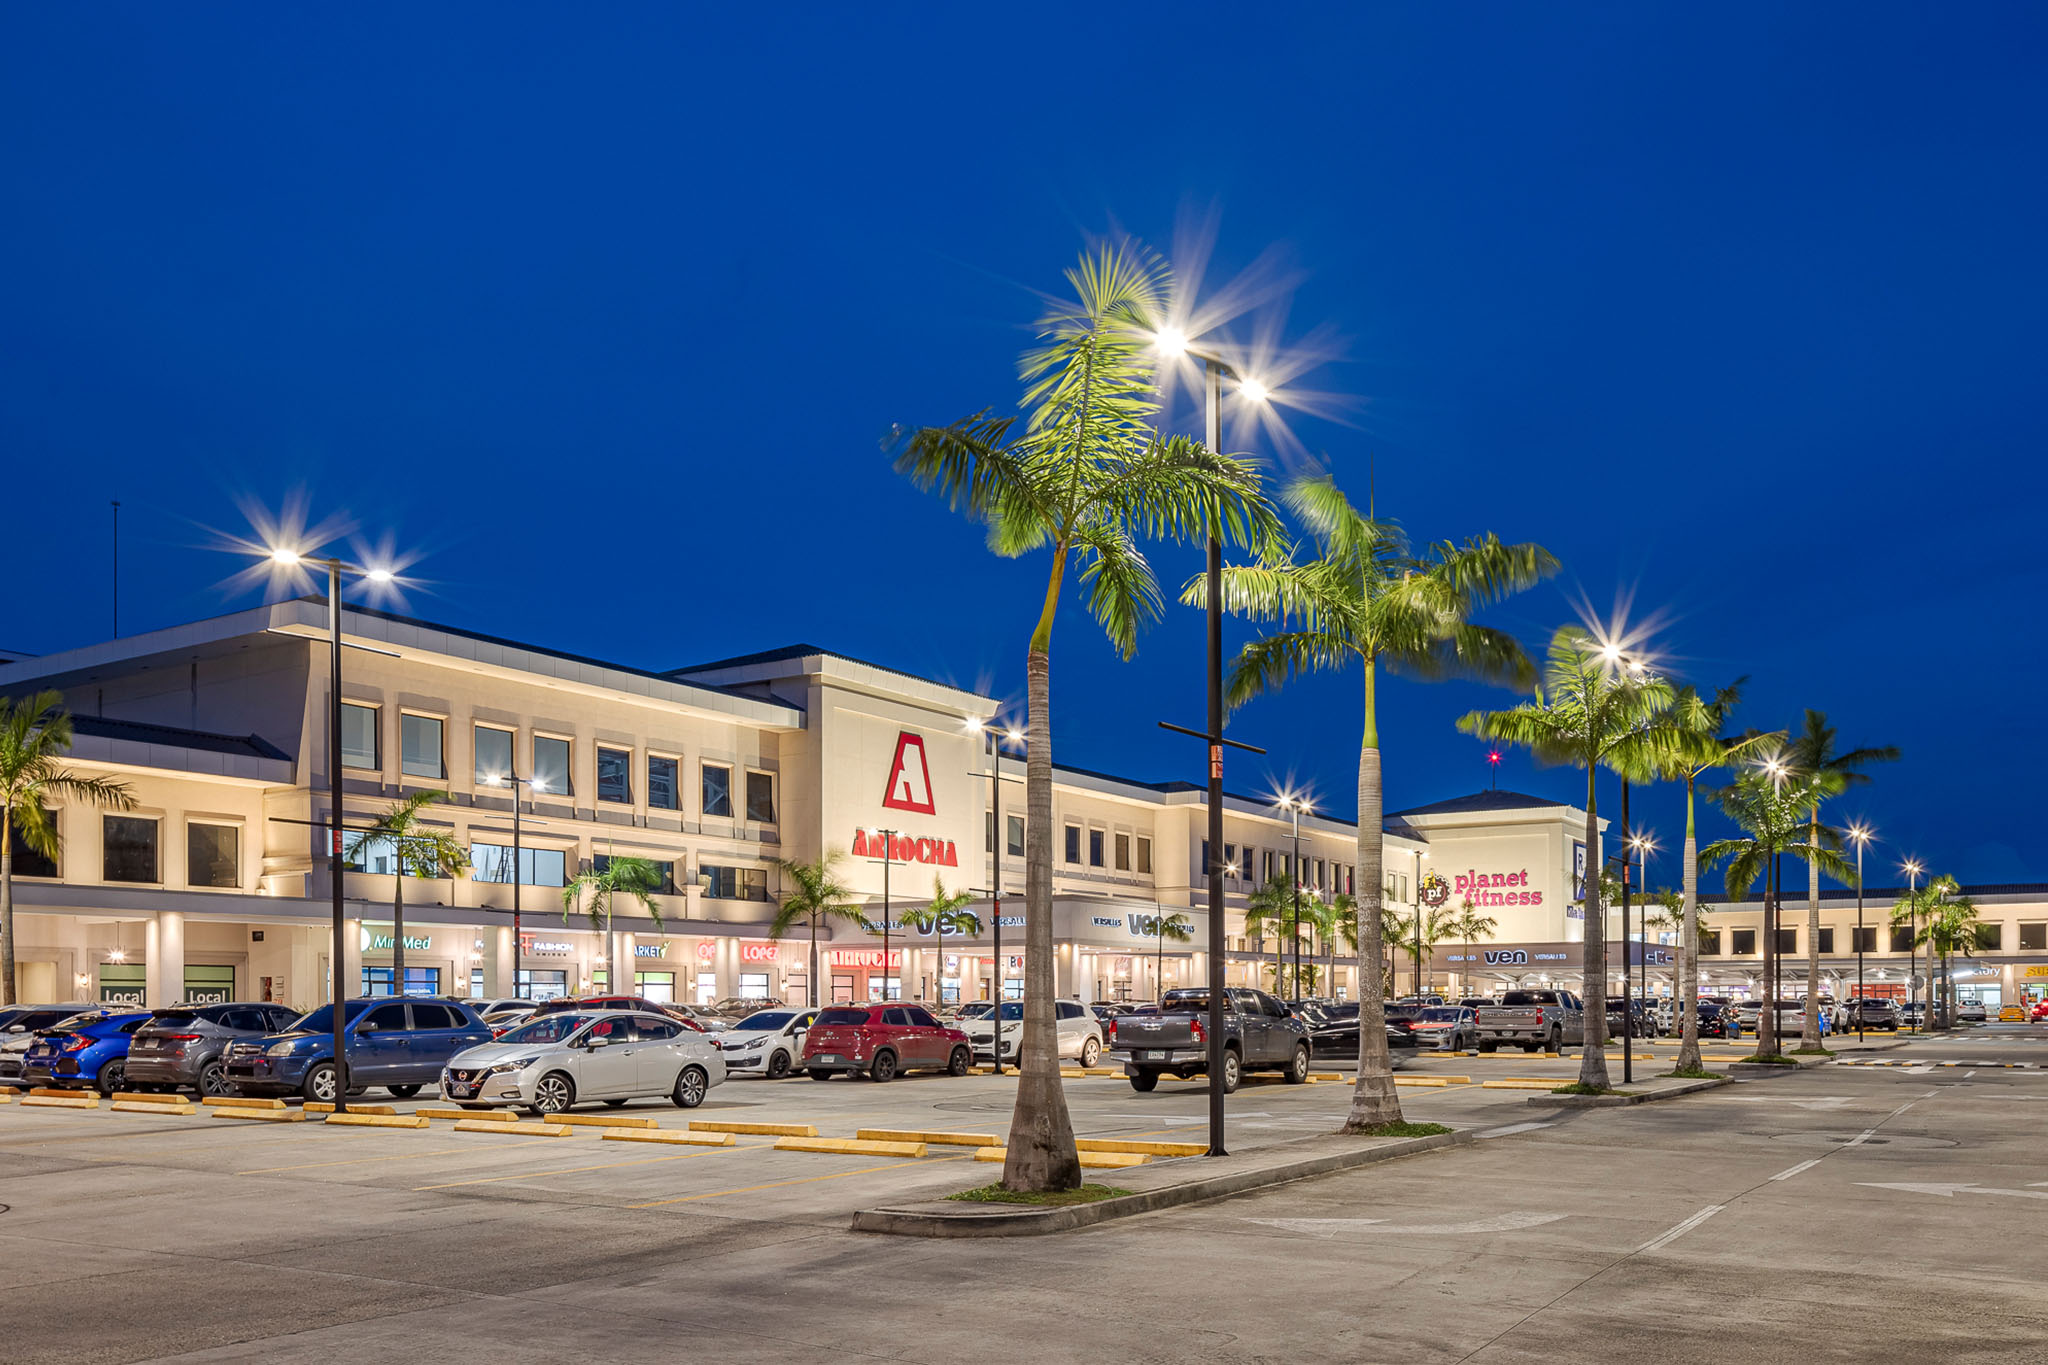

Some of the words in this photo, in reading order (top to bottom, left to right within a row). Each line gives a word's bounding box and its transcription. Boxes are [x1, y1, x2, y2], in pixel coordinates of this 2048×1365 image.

[852, 828, 958, 867] ARROCHA
[1454, 869, 1528, 894] planet
[1427, 886, 1442, 901] pf
[1464, 888, 1542, 907] fitness
[534, 942, 574, 951] FASHION
[743, 946, 779, 960] LOPEZ
[1484, 949, 1528, 965] ven
[105, 990, 144, 1004] Local
[189, 990, 226, 1003] Local
